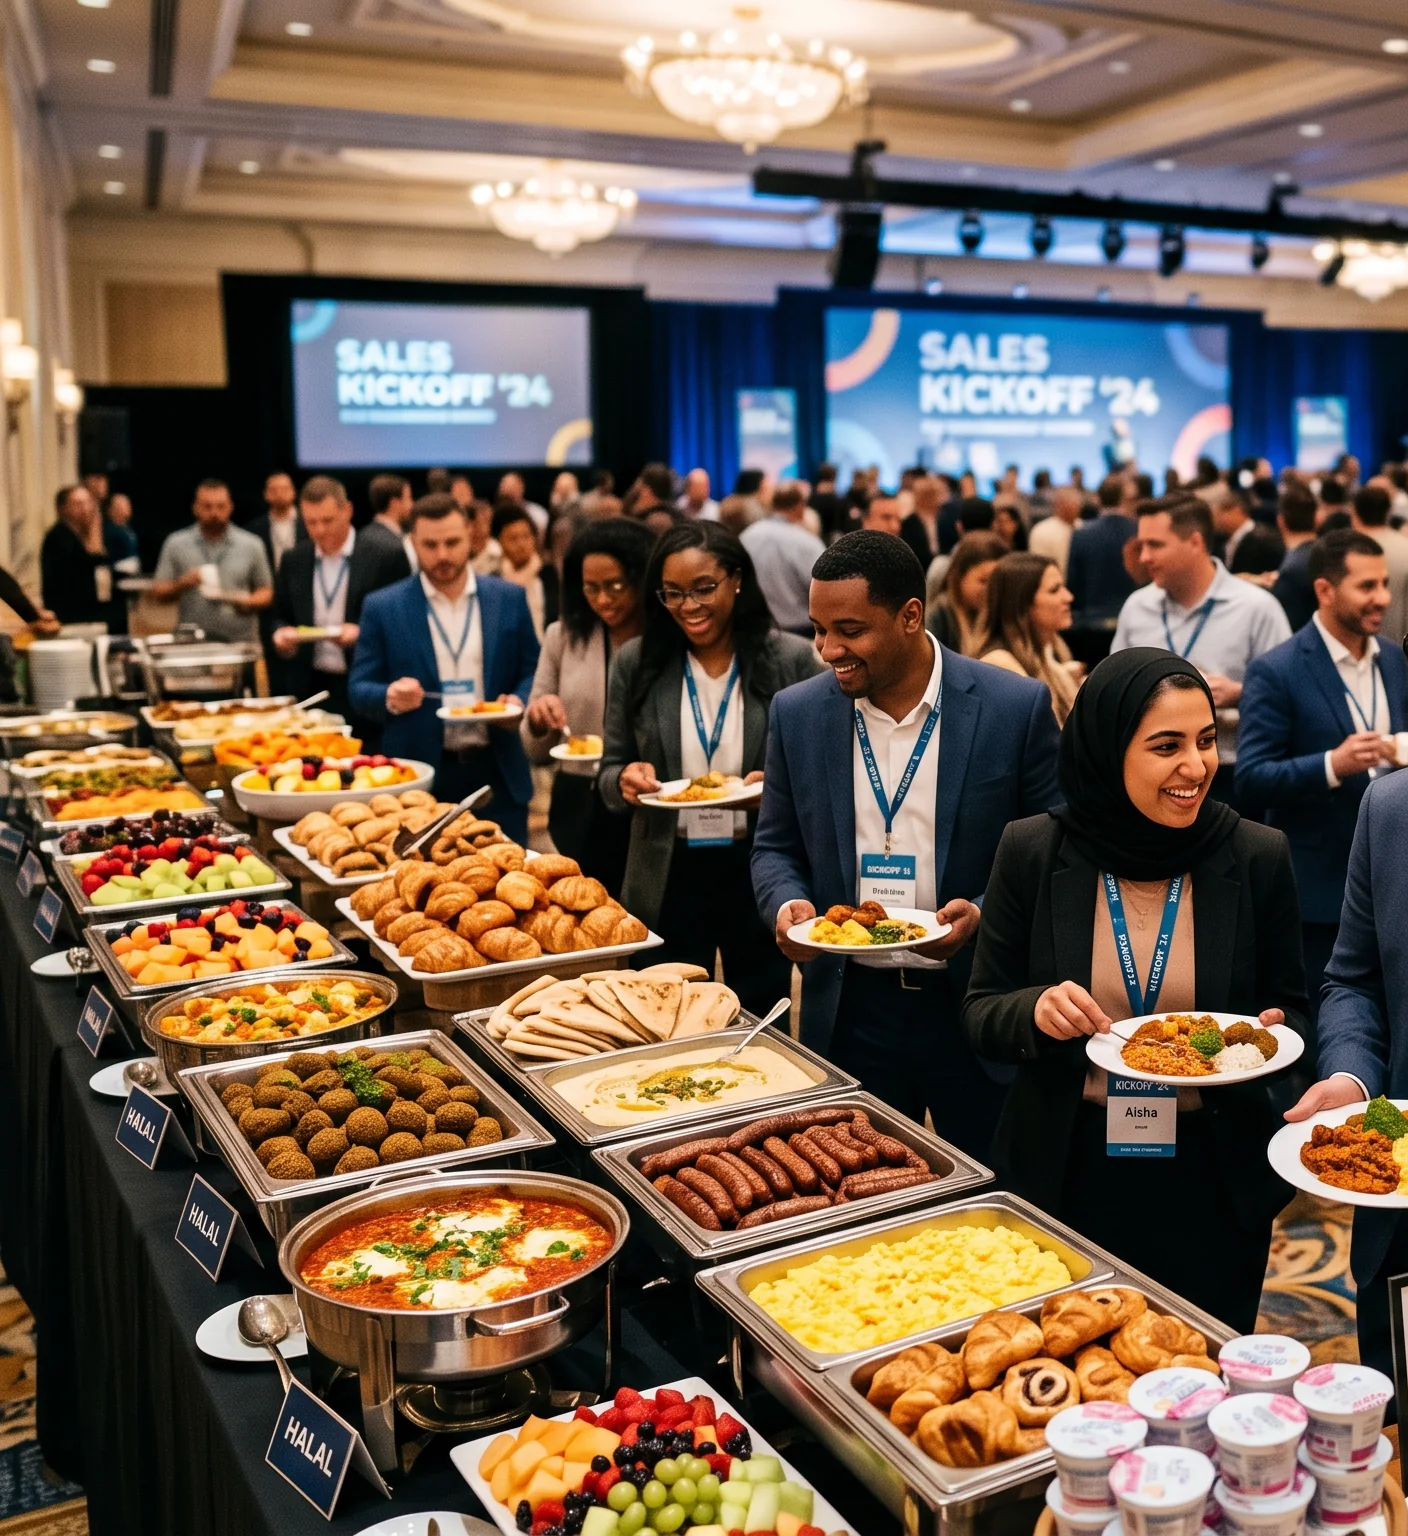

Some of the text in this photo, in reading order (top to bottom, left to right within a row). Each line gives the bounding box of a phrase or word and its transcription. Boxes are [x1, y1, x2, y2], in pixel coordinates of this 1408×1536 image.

[336, 338, 454, 373] SALES
[919, 330, 1051, 374] SALES
[337, 373, 553, 409] KICKOFF '24
[919, 373, 1160, 417] KICKOFF '24
[125, 1106, 156, 1144] HALAL
[1125, 1106, 1158, 1118] Aisha
[188, 1202, 219, 1247] HALAL
[284, 1415, 333, 1478] HALAL
